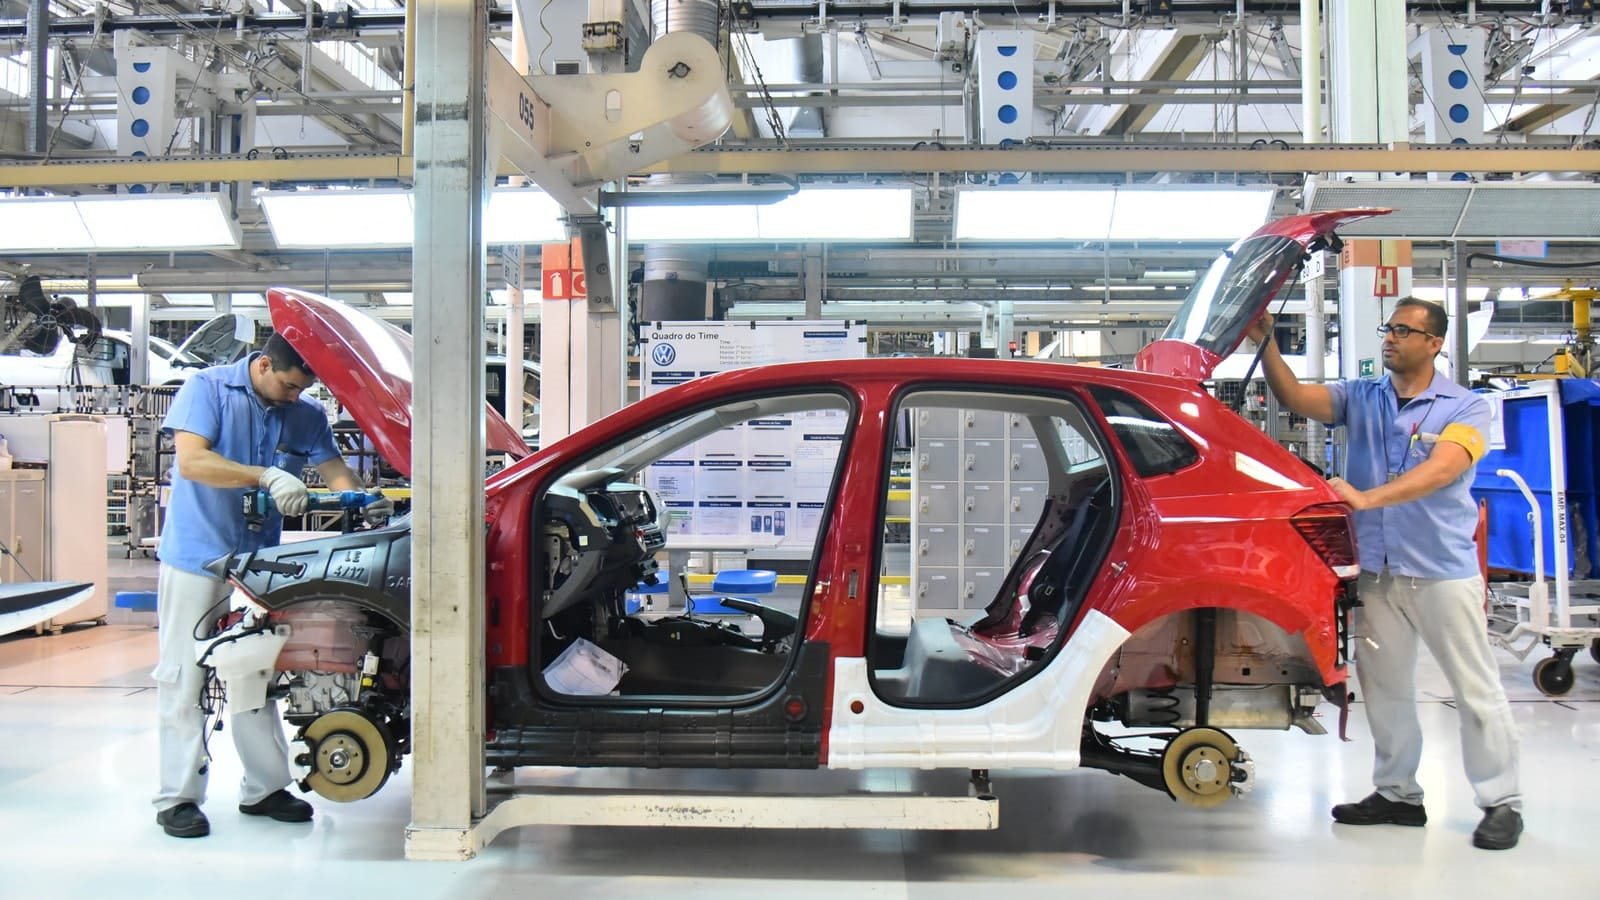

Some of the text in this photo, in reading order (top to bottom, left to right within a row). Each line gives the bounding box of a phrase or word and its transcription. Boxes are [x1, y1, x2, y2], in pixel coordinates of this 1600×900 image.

[519, 92, 534, 130] 055
[1376, 269, 1393, 295] H
[651, 332, 719, 340] Quadro do Time
